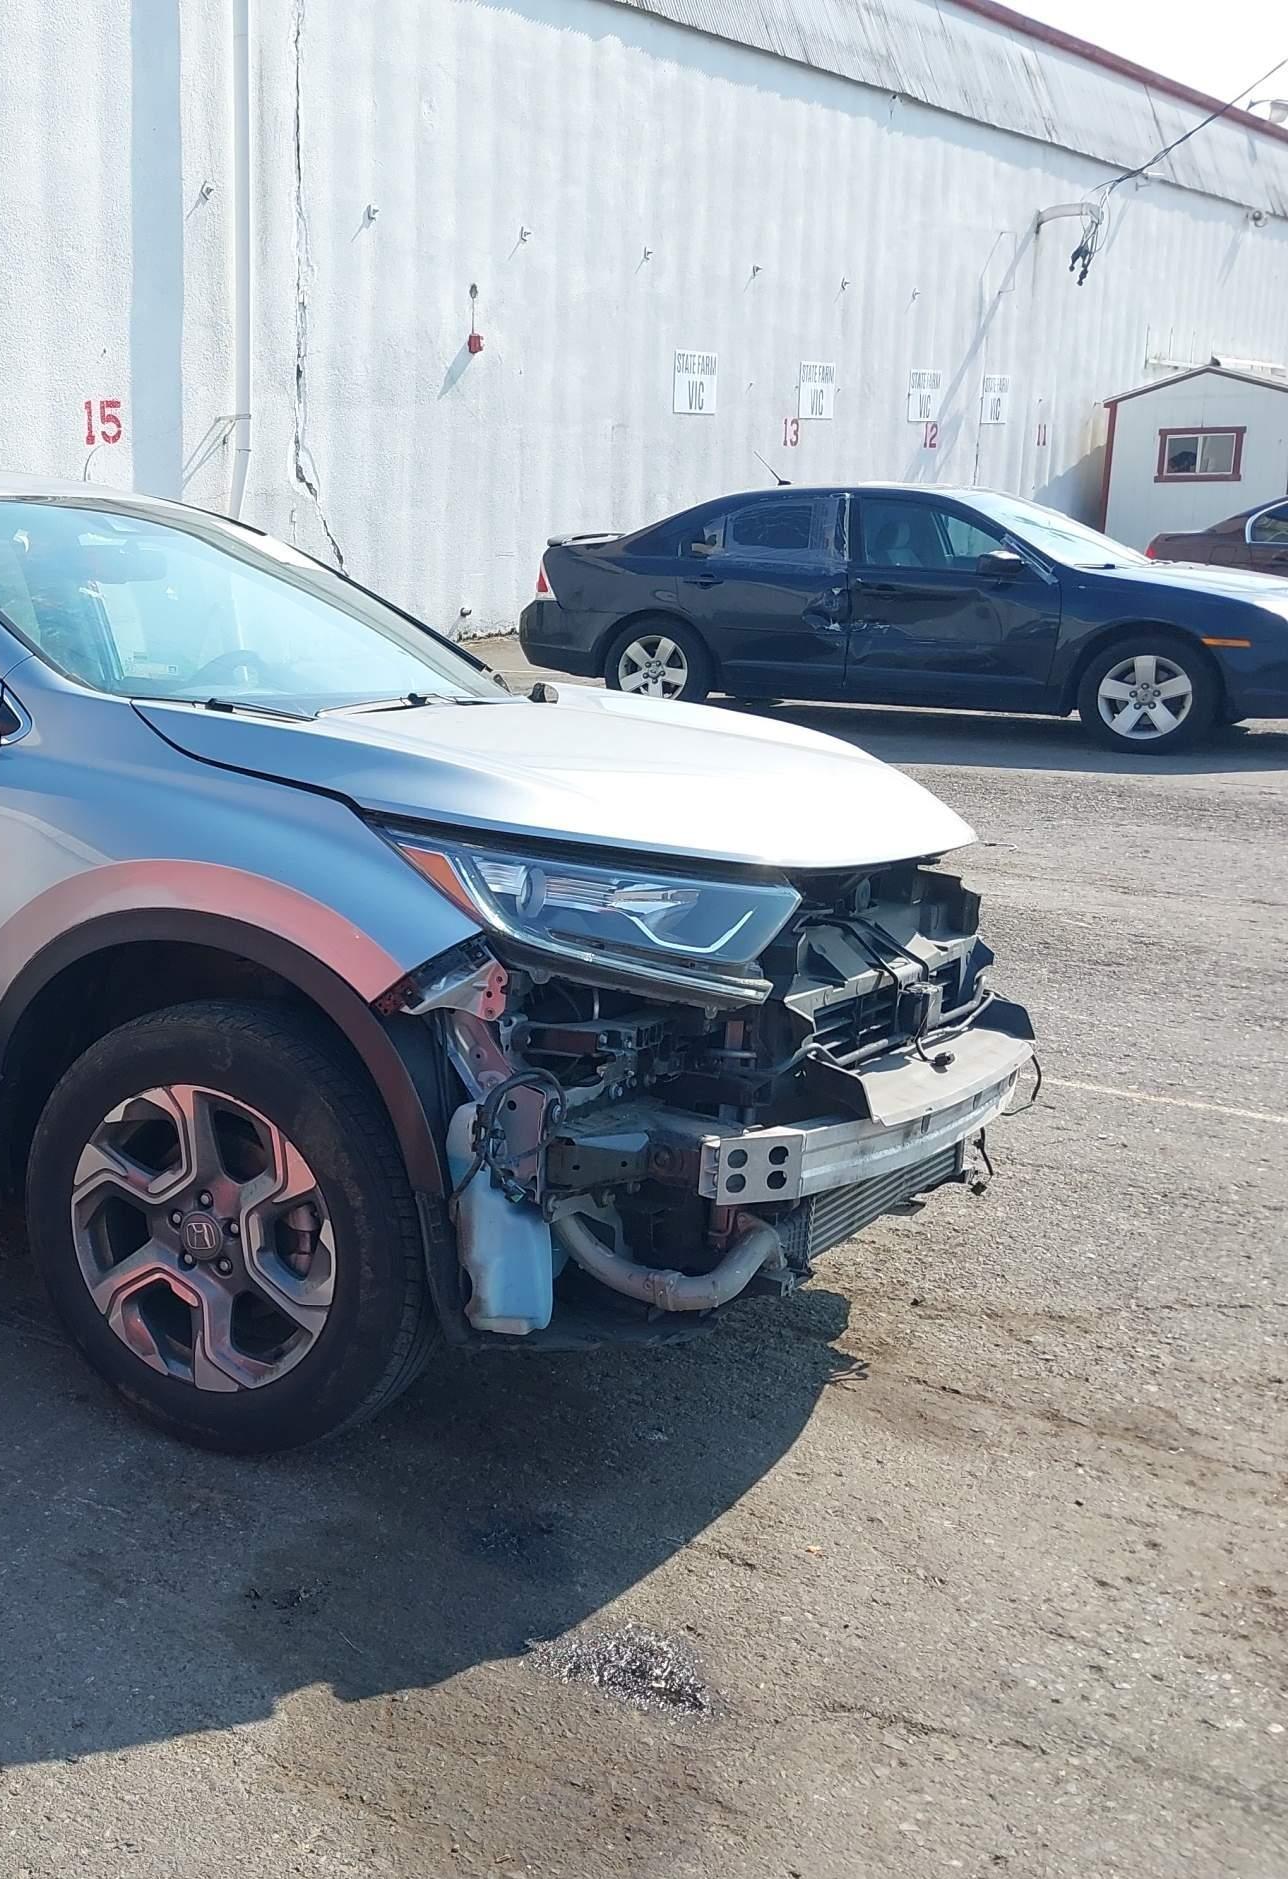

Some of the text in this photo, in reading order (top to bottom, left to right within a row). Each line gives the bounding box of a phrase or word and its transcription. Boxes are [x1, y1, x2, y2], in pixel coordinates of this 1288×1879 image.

[676, 352, 717, 376] STATE FARM
[802, 364, 835, 385] STATE FARM
[688, 380, 705, 411] VIC
[810, 388, 824, 416] VIC
[919, 393, 931, 419] VIC
[84, 400, 122, 445] 15
[783, 418, 800, 447] 13
[923, 422, 939, 449] 12
[1036, 423, 1047, 446] 11
